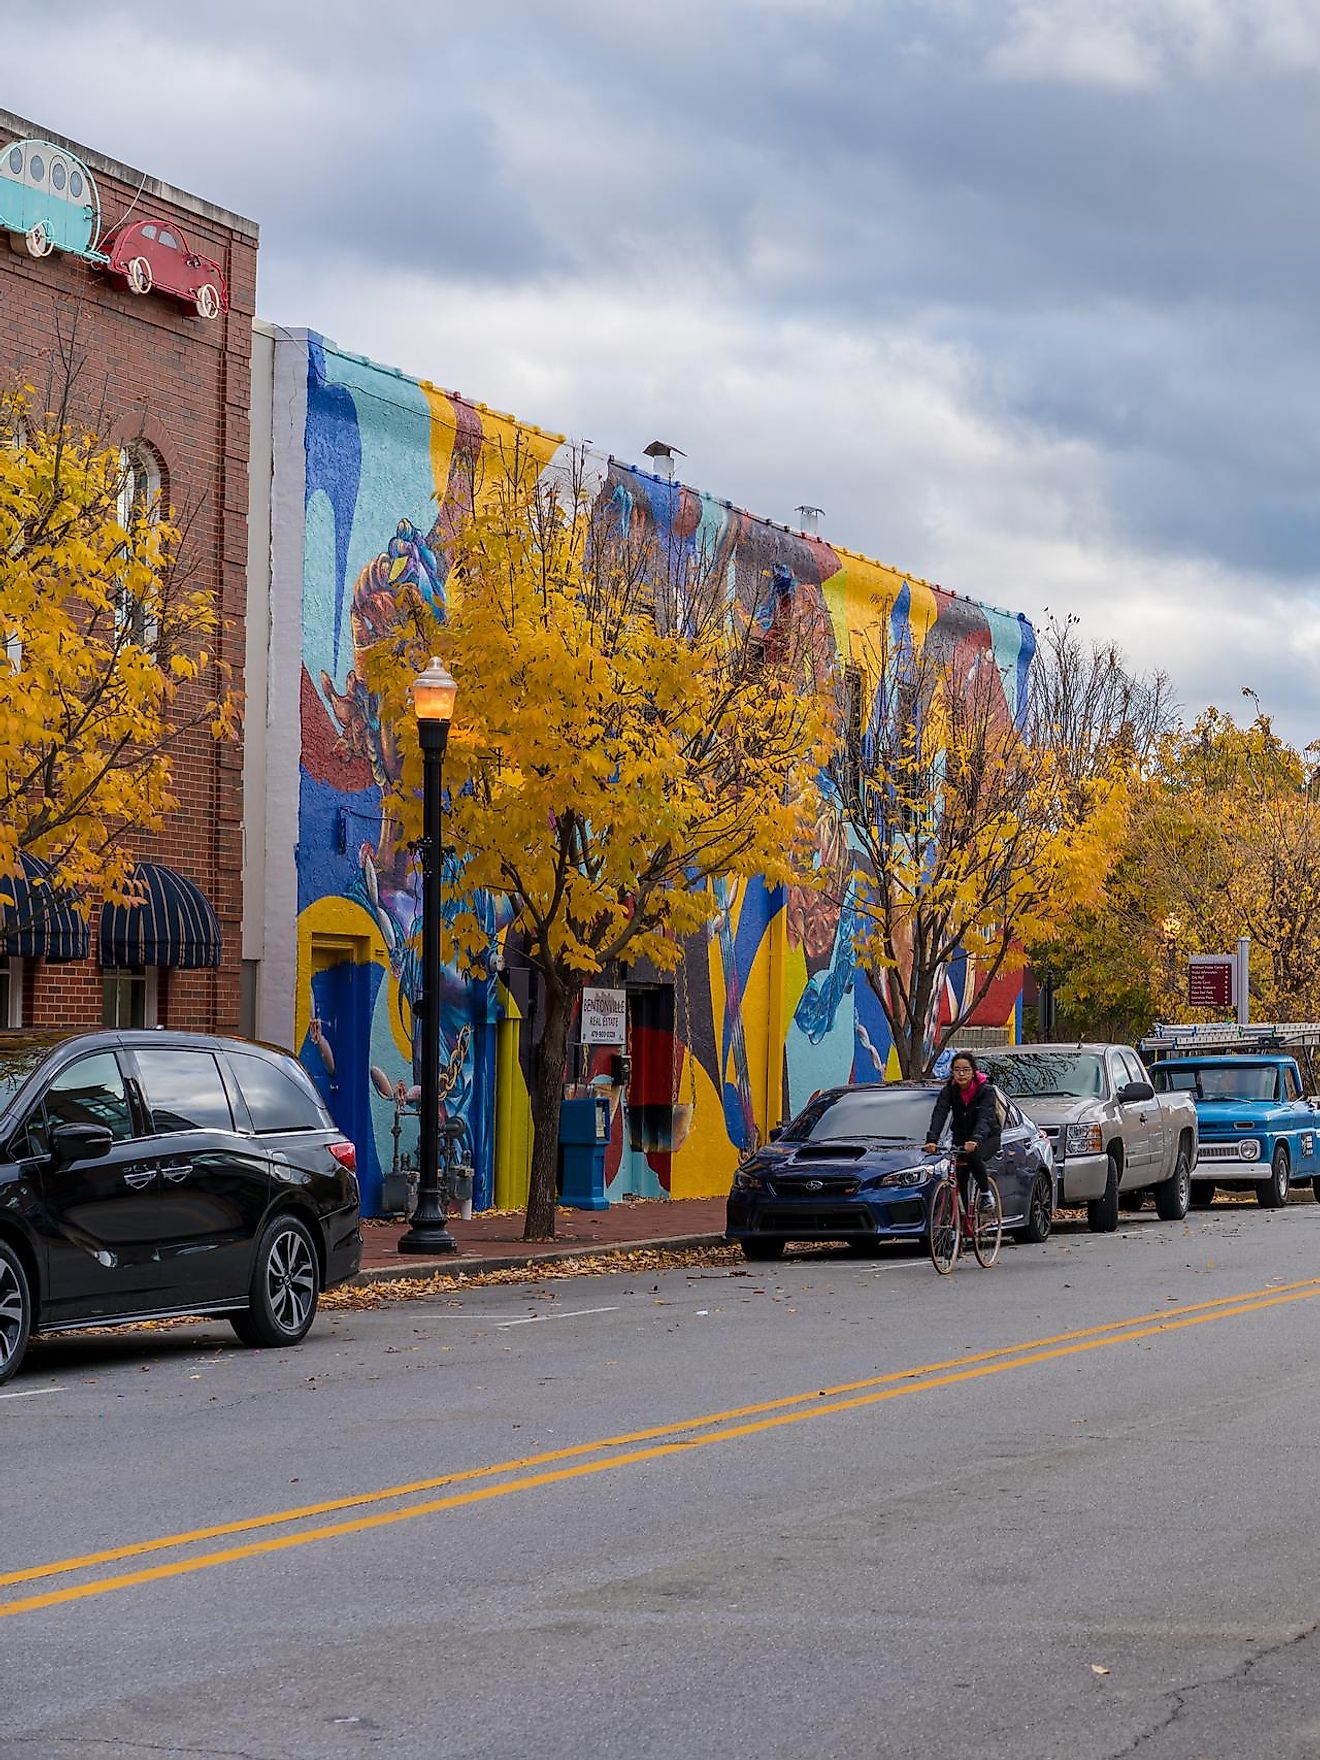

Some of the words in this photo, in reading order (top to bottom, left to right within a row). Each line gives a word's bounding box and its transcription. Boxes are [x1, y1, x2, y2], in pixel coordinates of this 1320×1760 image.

[584, 998, 624, 1013] BENTONVILLE
[590, 1016, 601, 1027] REAL
[602, 1017, 619, 1027] ESTATE
